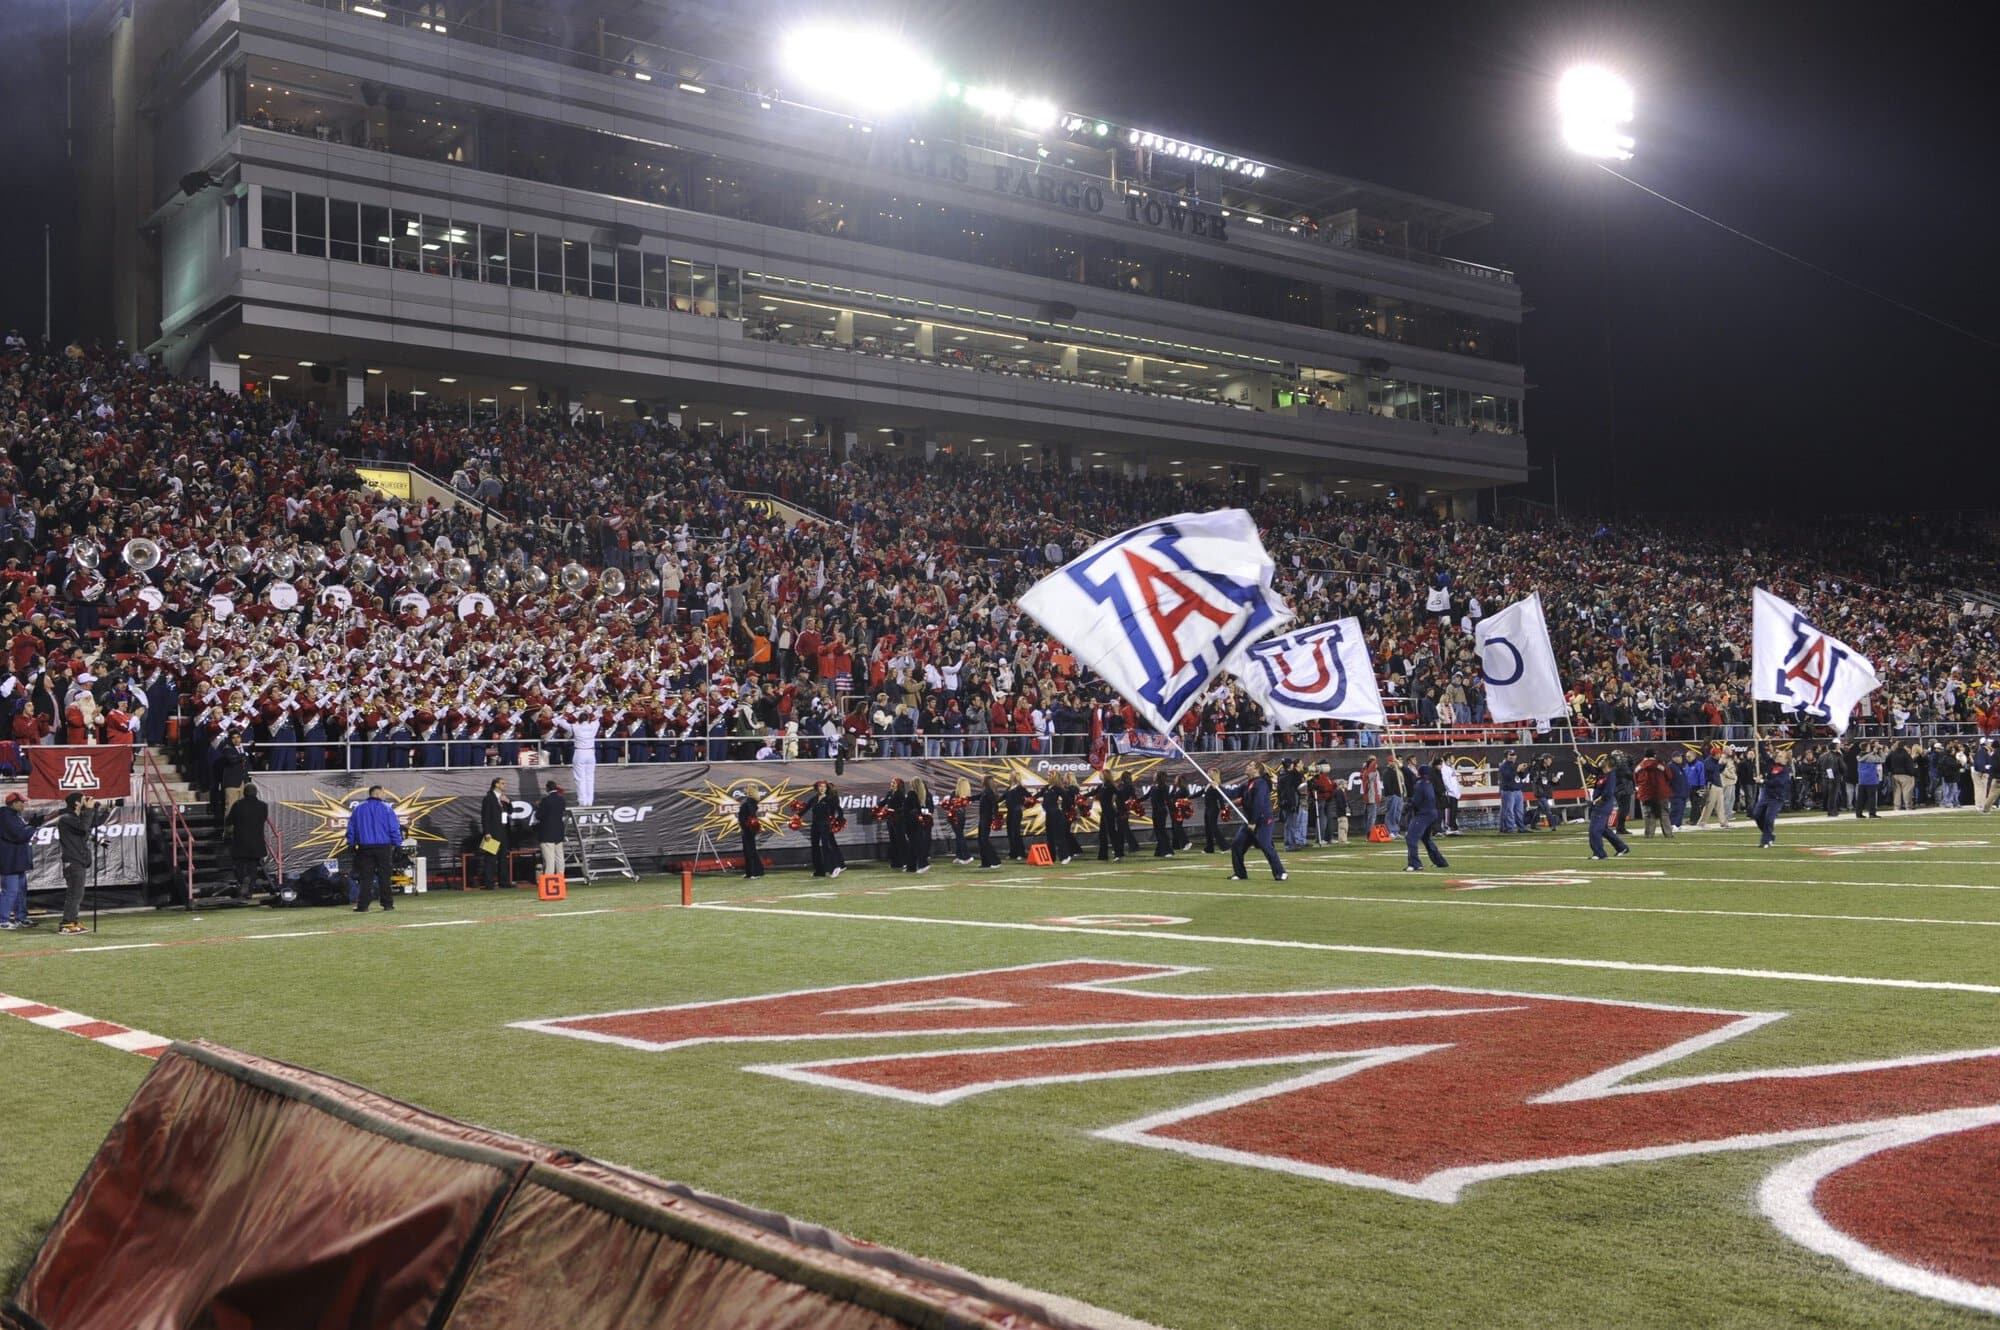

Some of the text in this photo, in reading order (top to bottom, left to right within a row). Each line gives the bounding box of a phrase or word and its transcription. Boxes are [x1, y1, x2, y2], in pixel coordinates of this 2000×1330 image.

[993, 165, 1104, 214] FARGO
[1125, 195, 1229, 242] TOWER
[1246, 624, 1348, 712] U
[58, 756, 100, 791] A
[1037, 760, 1092, 772] Pioneer
[1035, 846, 1050, 862] 10
[545, 877, 560, 896] G
